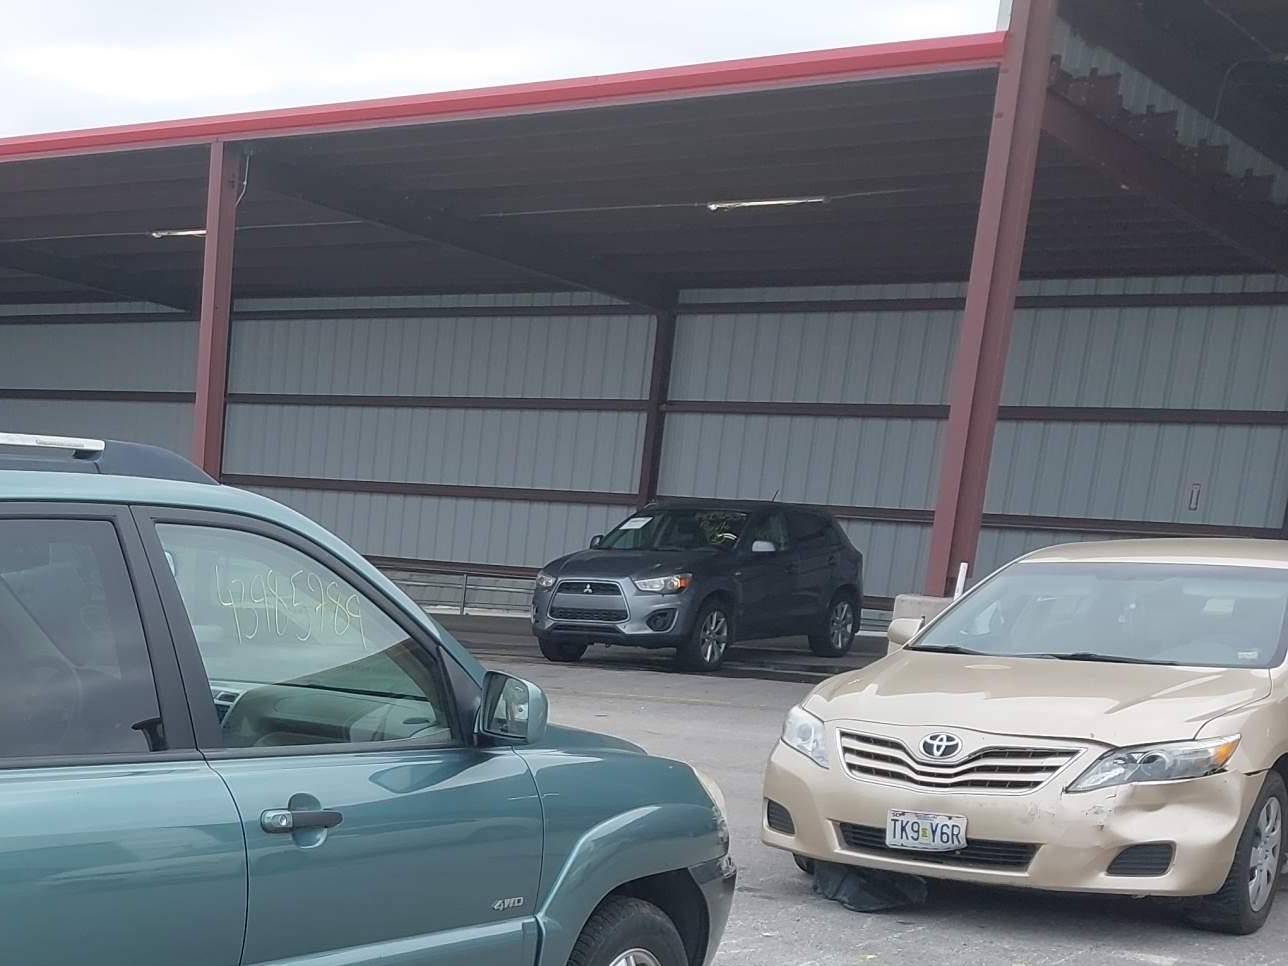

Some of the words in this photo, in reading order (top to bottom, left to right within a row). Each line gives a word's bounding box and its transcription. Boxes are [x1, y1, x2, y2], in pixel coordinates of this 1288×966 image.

[215, 565, 367, 649] 43985789
[890, 818, 920, 841] TK9
[930, 822, 961, 845] Y6R
[493, 896, 524, 911] 4WD
